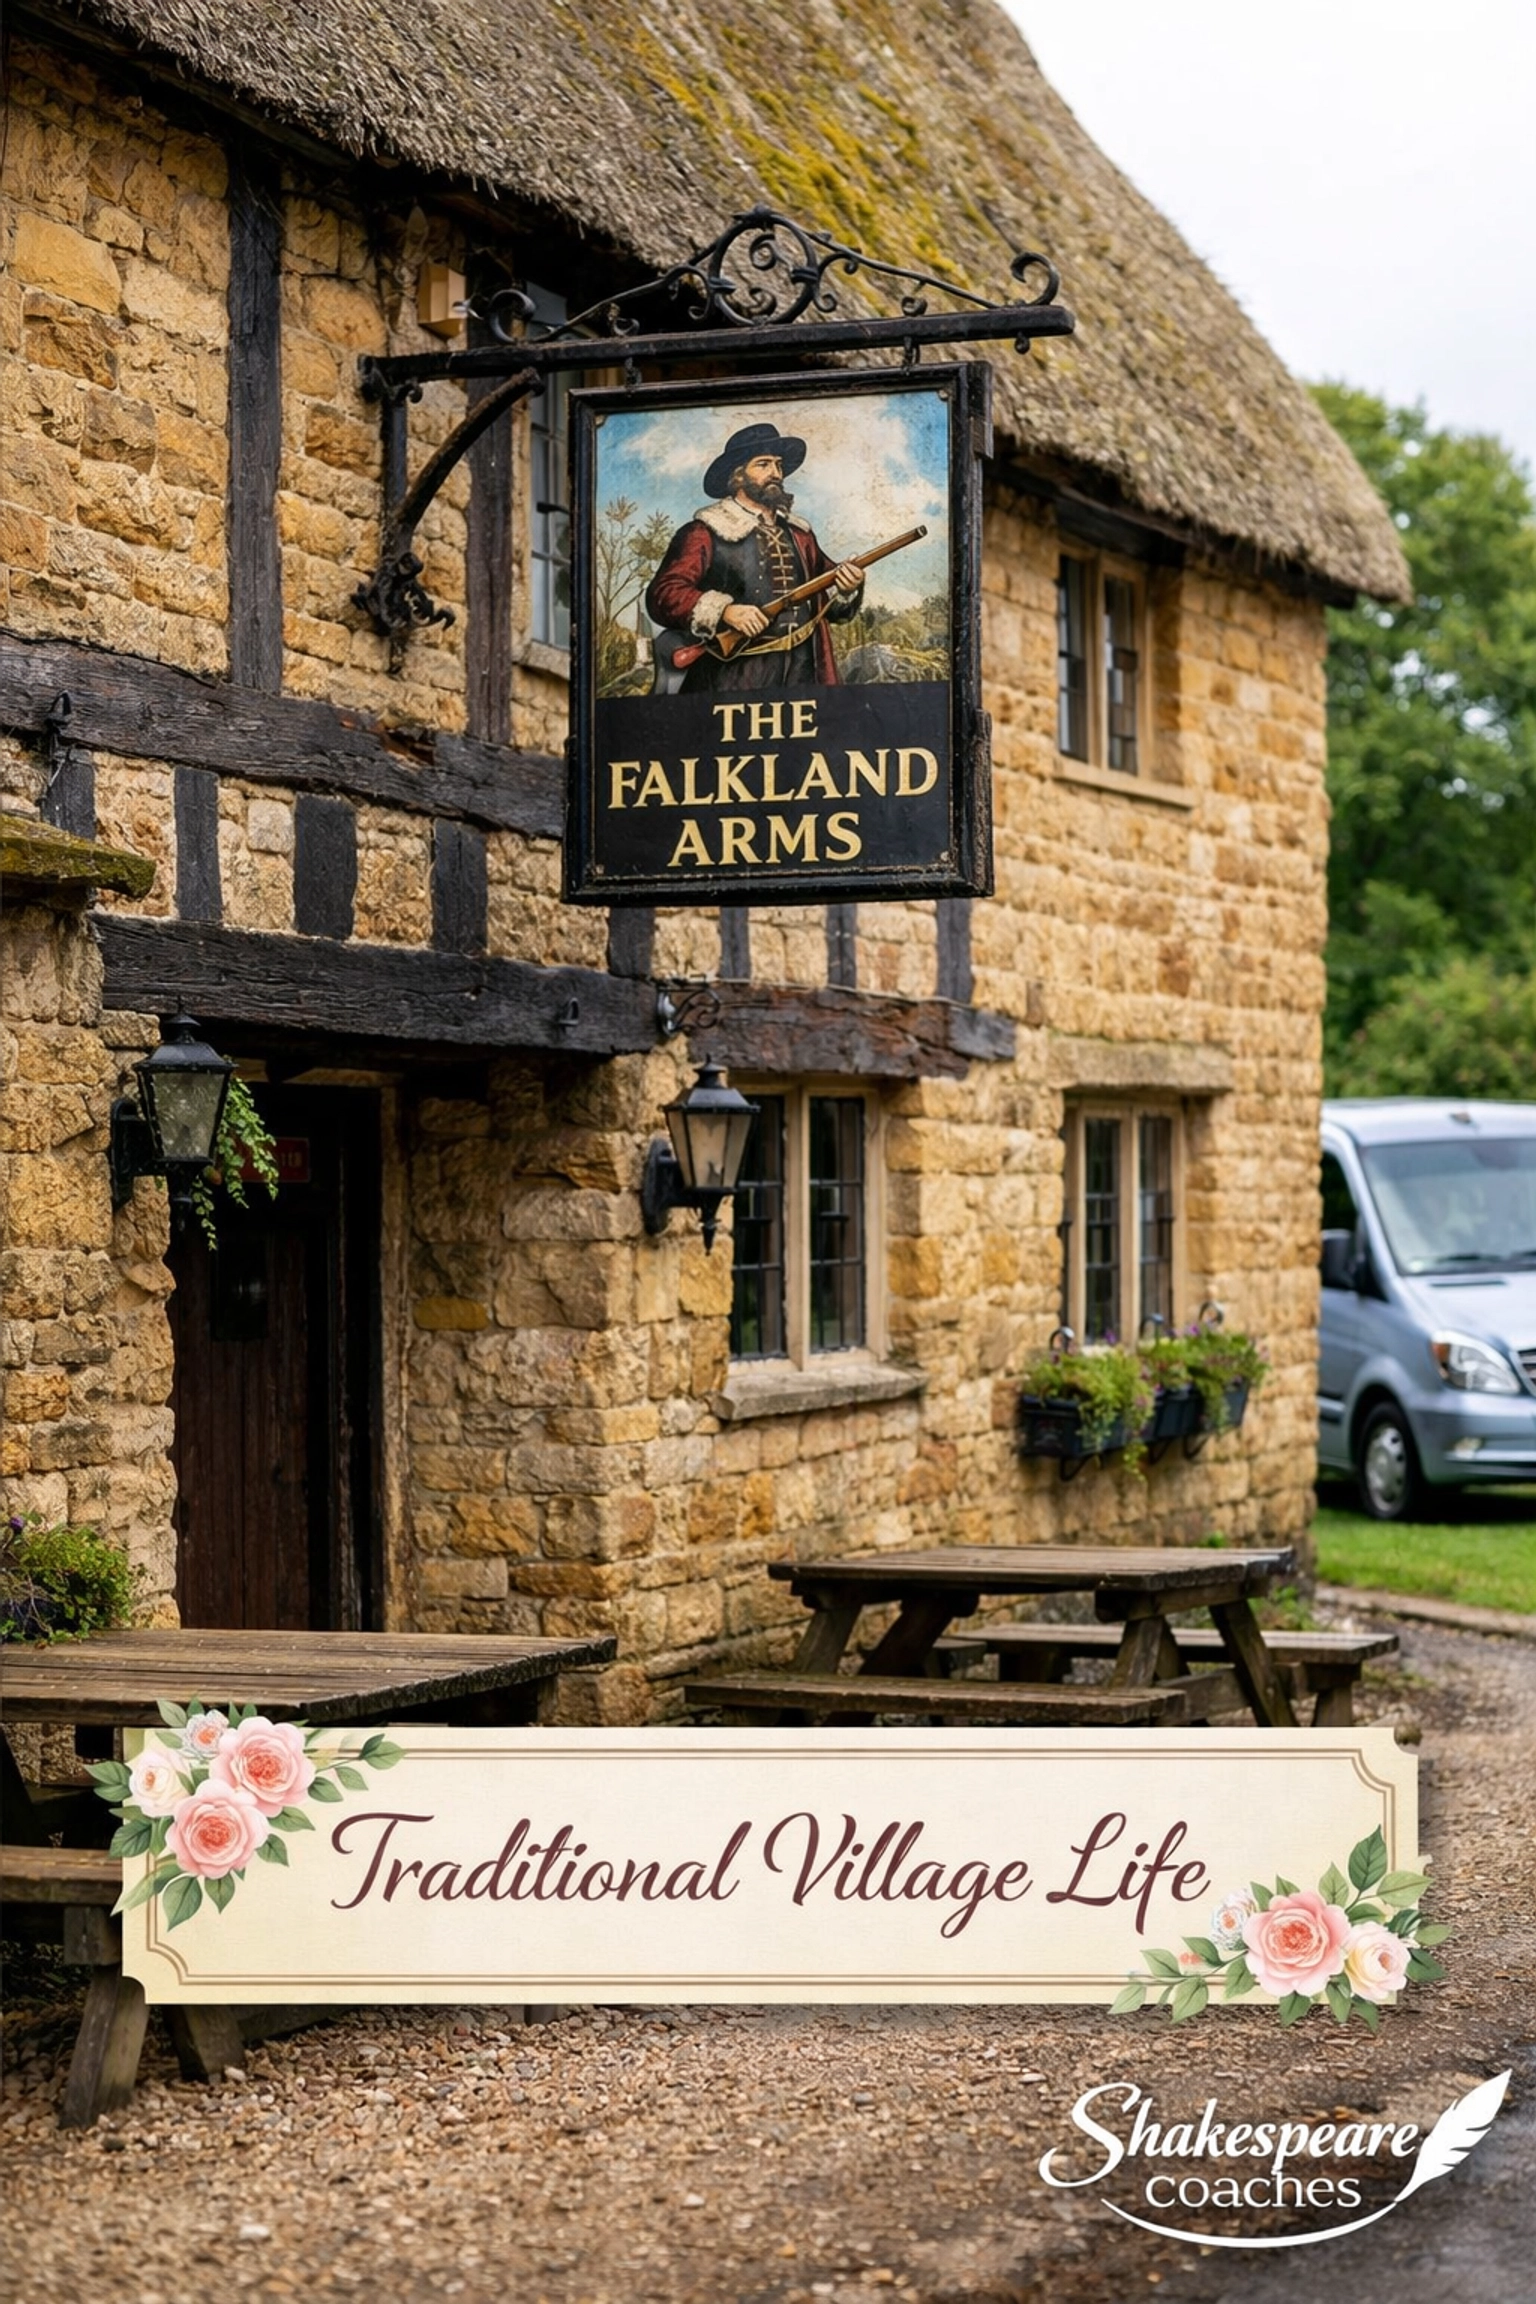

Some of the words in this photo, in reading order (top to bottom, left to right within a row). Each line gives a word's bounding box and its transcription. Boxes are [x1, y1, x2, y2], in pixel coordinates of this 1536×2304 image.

[713, 699, 818, 742] THE
[607, 747, 939, 809] FALKLAND
[667, 812, 863, 867] ARMS
